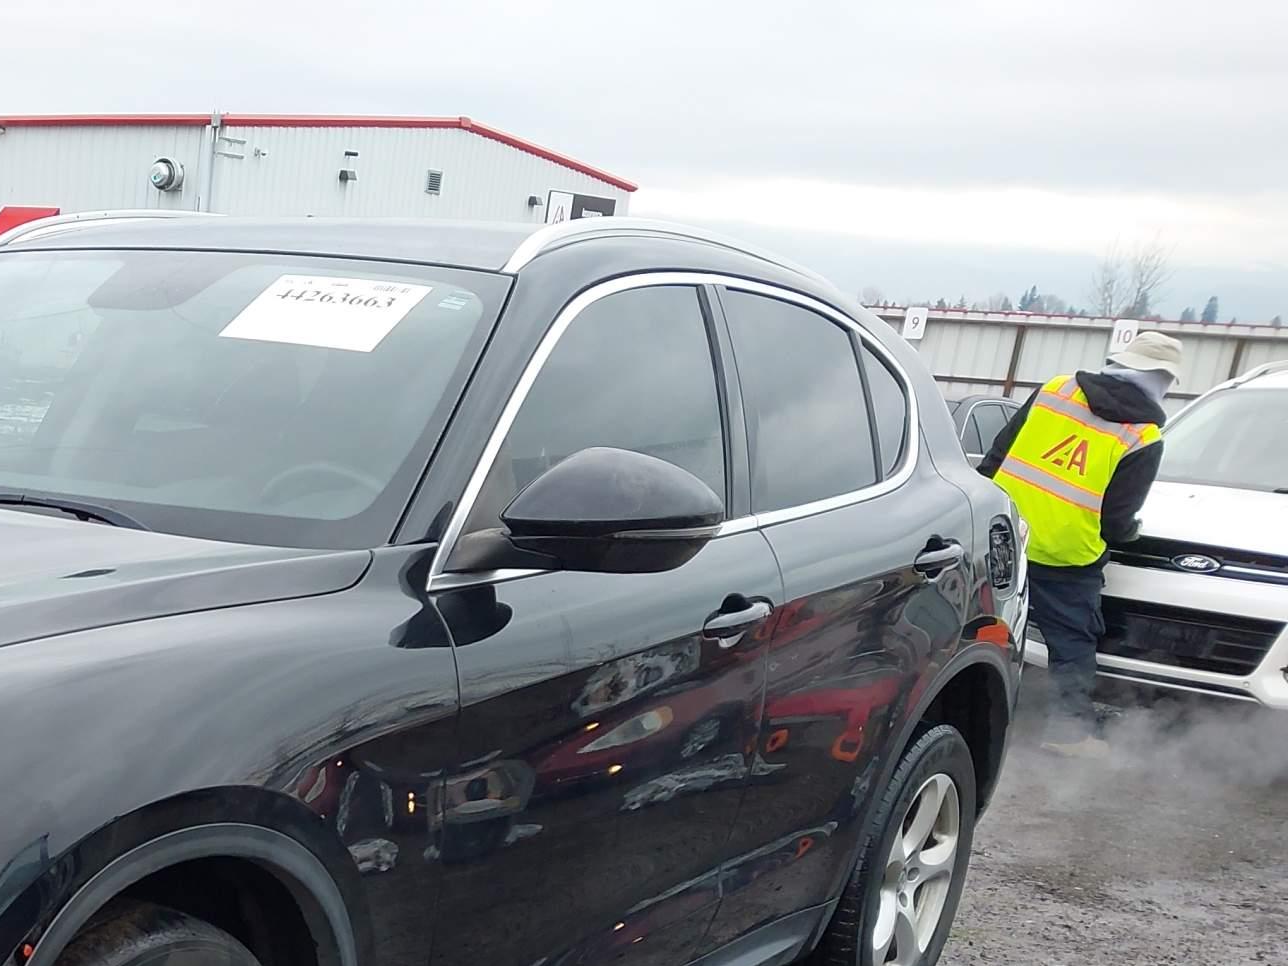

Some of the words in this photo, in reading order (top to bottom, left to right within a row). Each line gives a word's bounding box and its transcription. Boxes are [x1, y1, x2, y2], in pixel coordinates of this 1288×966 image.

[276, 289, 396, 309] 44263663
[912, 316, 920, 330] 9
[1117, 329, 1133, 344] 10
[1180, 556, 1209, 569] Ford
